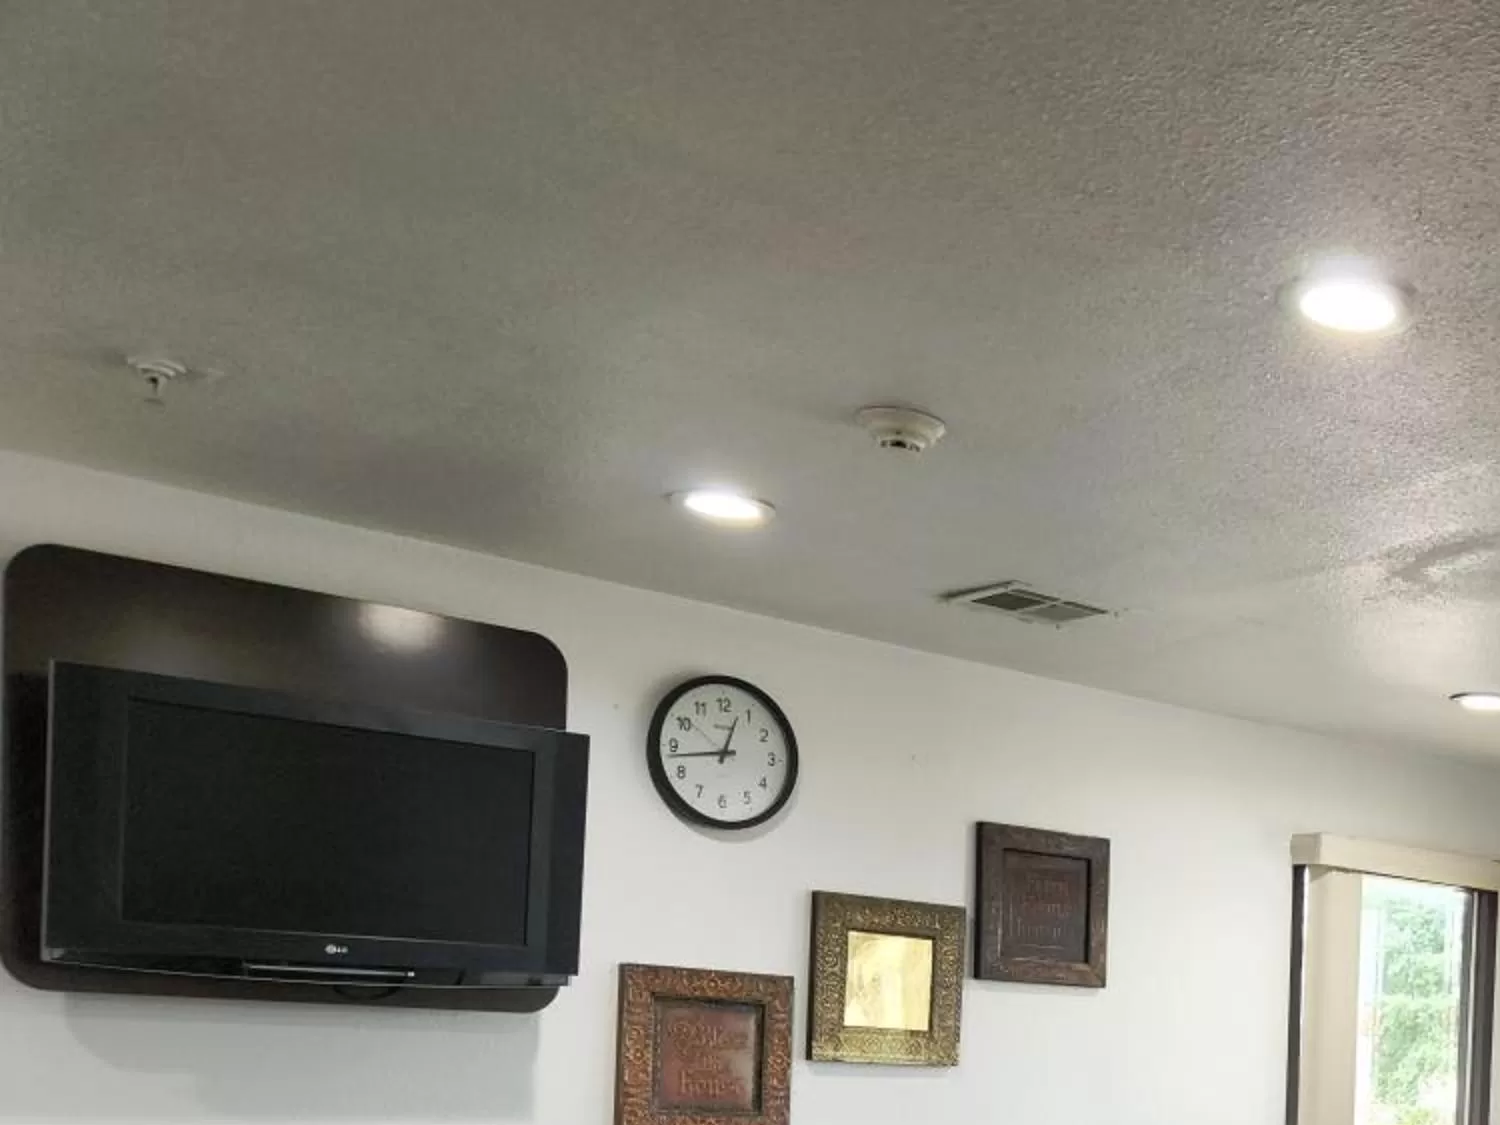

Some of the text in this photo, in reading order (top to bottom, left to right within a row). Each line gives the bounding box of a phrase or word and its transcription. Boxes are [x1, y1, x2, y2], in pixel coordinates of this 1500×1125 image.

[694, 701, 707, 717] 11
[716, 697, 732, 713] 12
[676, 715, 692, 732] 10
[745, 708, 751, 724] 1
[758, 728, 769, 743] 2
[668, 737, 679, 753] 9
[767, 752, 776, 767] 3
[676, 765, 686, 780] 8
[758, 776, 767, 789] 4
[695, 783, 705, 798] 7
[743, 790, 751, 805] 5
[717, 794, 727, 809] 6
